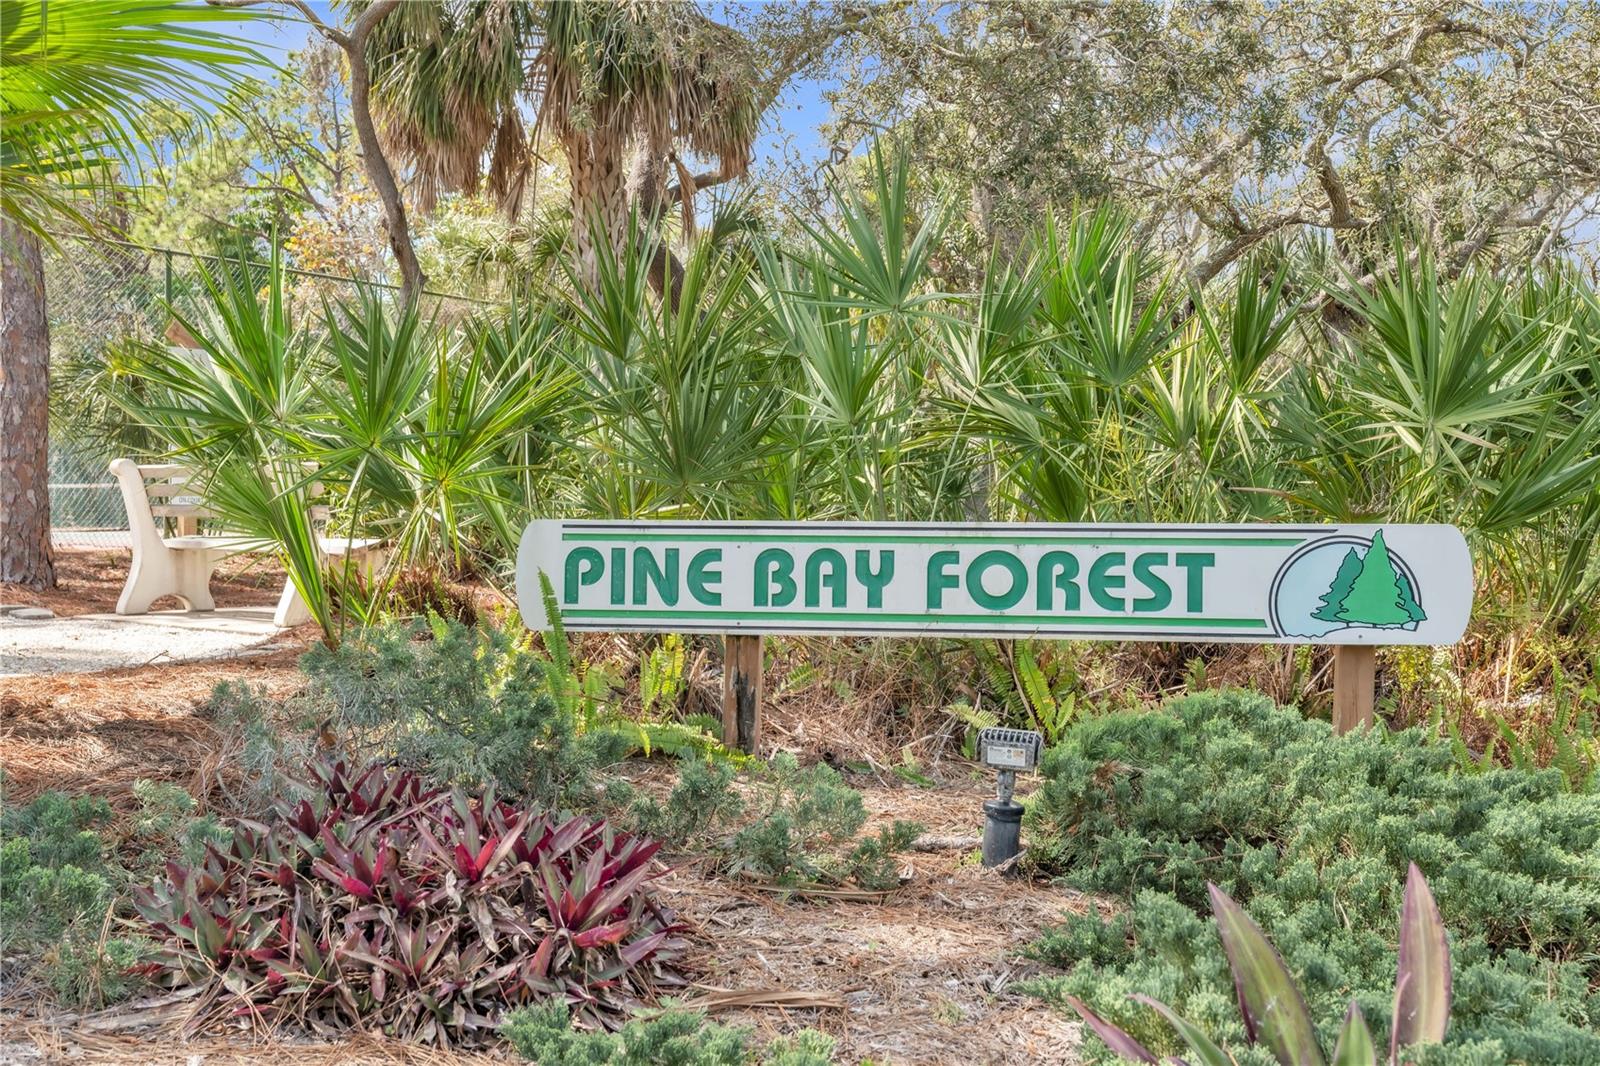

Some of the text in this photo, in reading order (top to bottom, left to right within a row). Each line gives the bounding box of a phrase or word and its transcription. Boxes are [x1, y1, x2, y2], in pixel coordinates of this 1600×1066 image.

[563, 547, 1216, 612] PINE BAY FOREST
